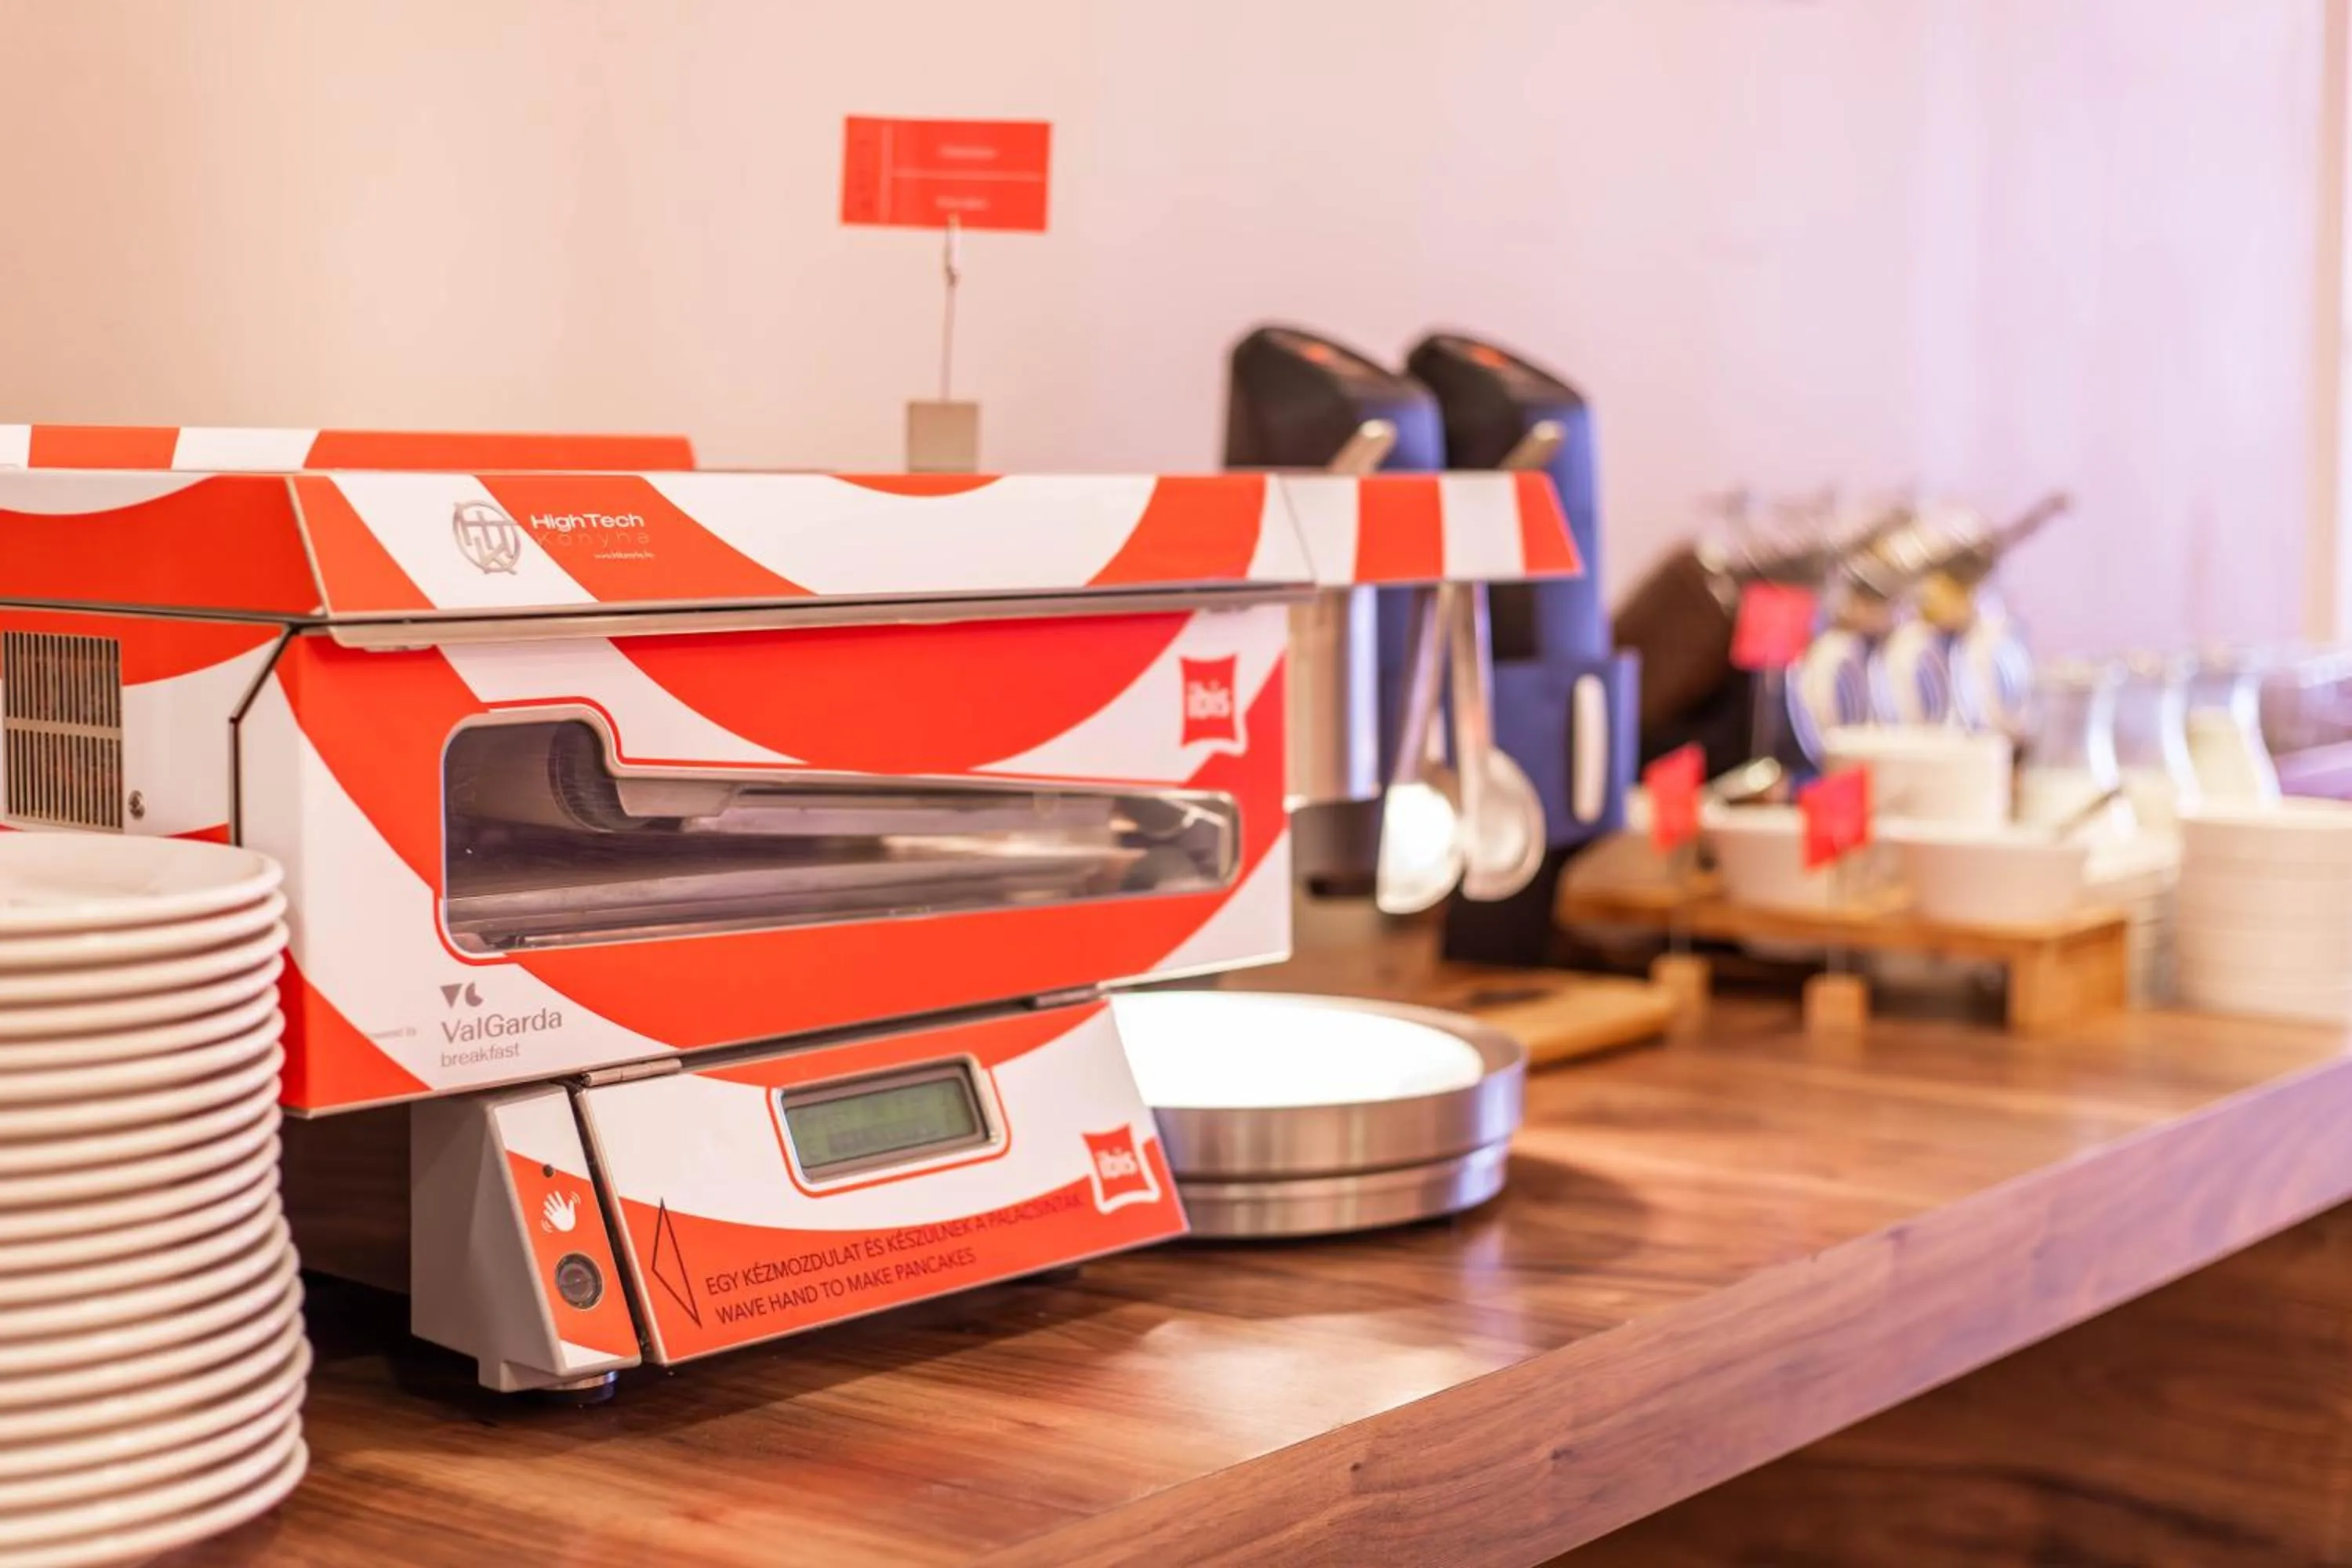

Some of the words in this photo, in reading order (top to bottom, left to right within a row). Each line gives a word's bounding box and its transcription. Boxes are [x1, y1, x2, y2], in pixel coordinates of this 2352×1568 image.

[530, 513, 644, 532] HighTech
[1187, 679, 1231, 720] ibis
[441, 1007, 563, 1044] ValGarda
[441, 1042, 521, 1068] breakfast
[1095, 1146, 1138, 1180] ibis
[706, 1272, 739, 1296] EGY
[742, 1242, 862, 1287] KÉZMOZDULAT
[864, 1236, 885, 1258] ÉS
[715, 1298, 768, 1325] WAVE
[768, 1285, 818, 1312] HAND
[819, 1279, 844, 1299] TO
[846, 1266, 894, 1293] MAKE
[895, 1247, 977, 1281] PANCAKES
